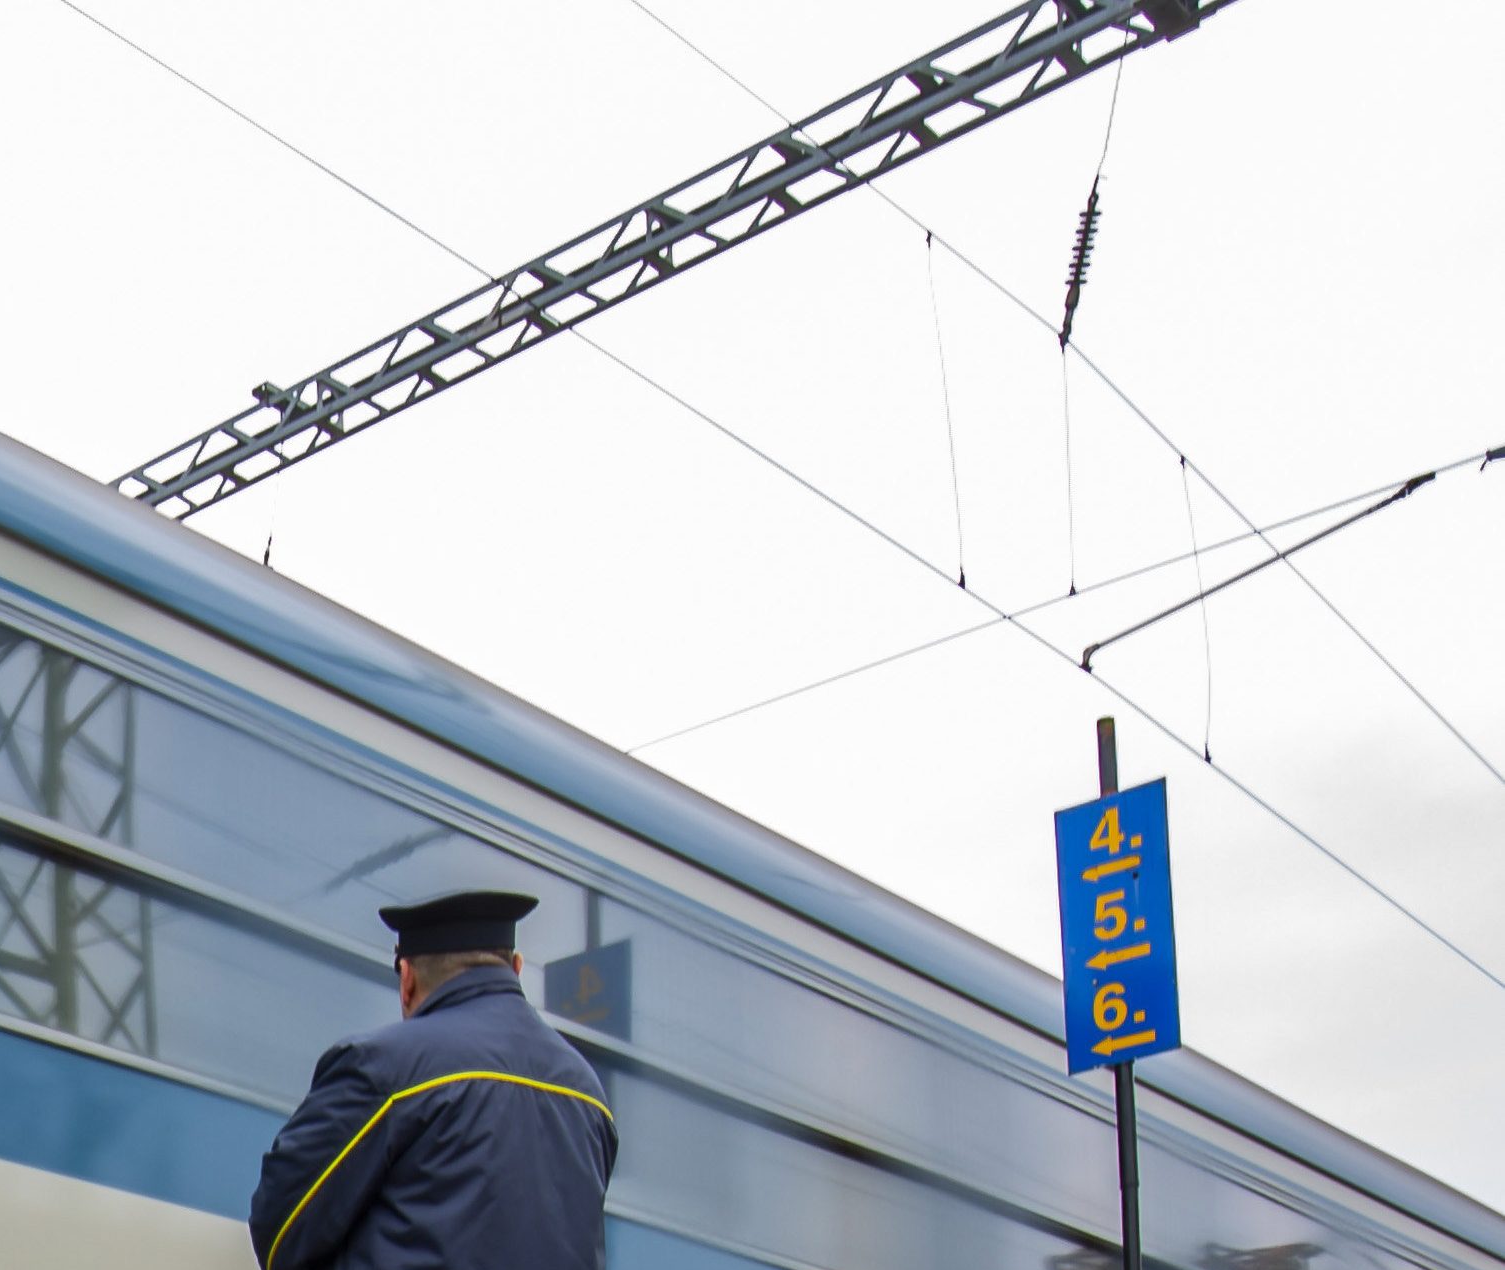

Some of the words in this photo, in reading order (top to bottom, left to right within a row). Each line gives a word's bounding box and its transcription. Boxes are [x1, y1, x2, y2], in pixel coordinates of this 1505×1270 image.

[1089, 806, 1143, 854] 4.
[1093, 889, 1146, 941] 5.
[1092, 982, 1146, 1031] 6.
